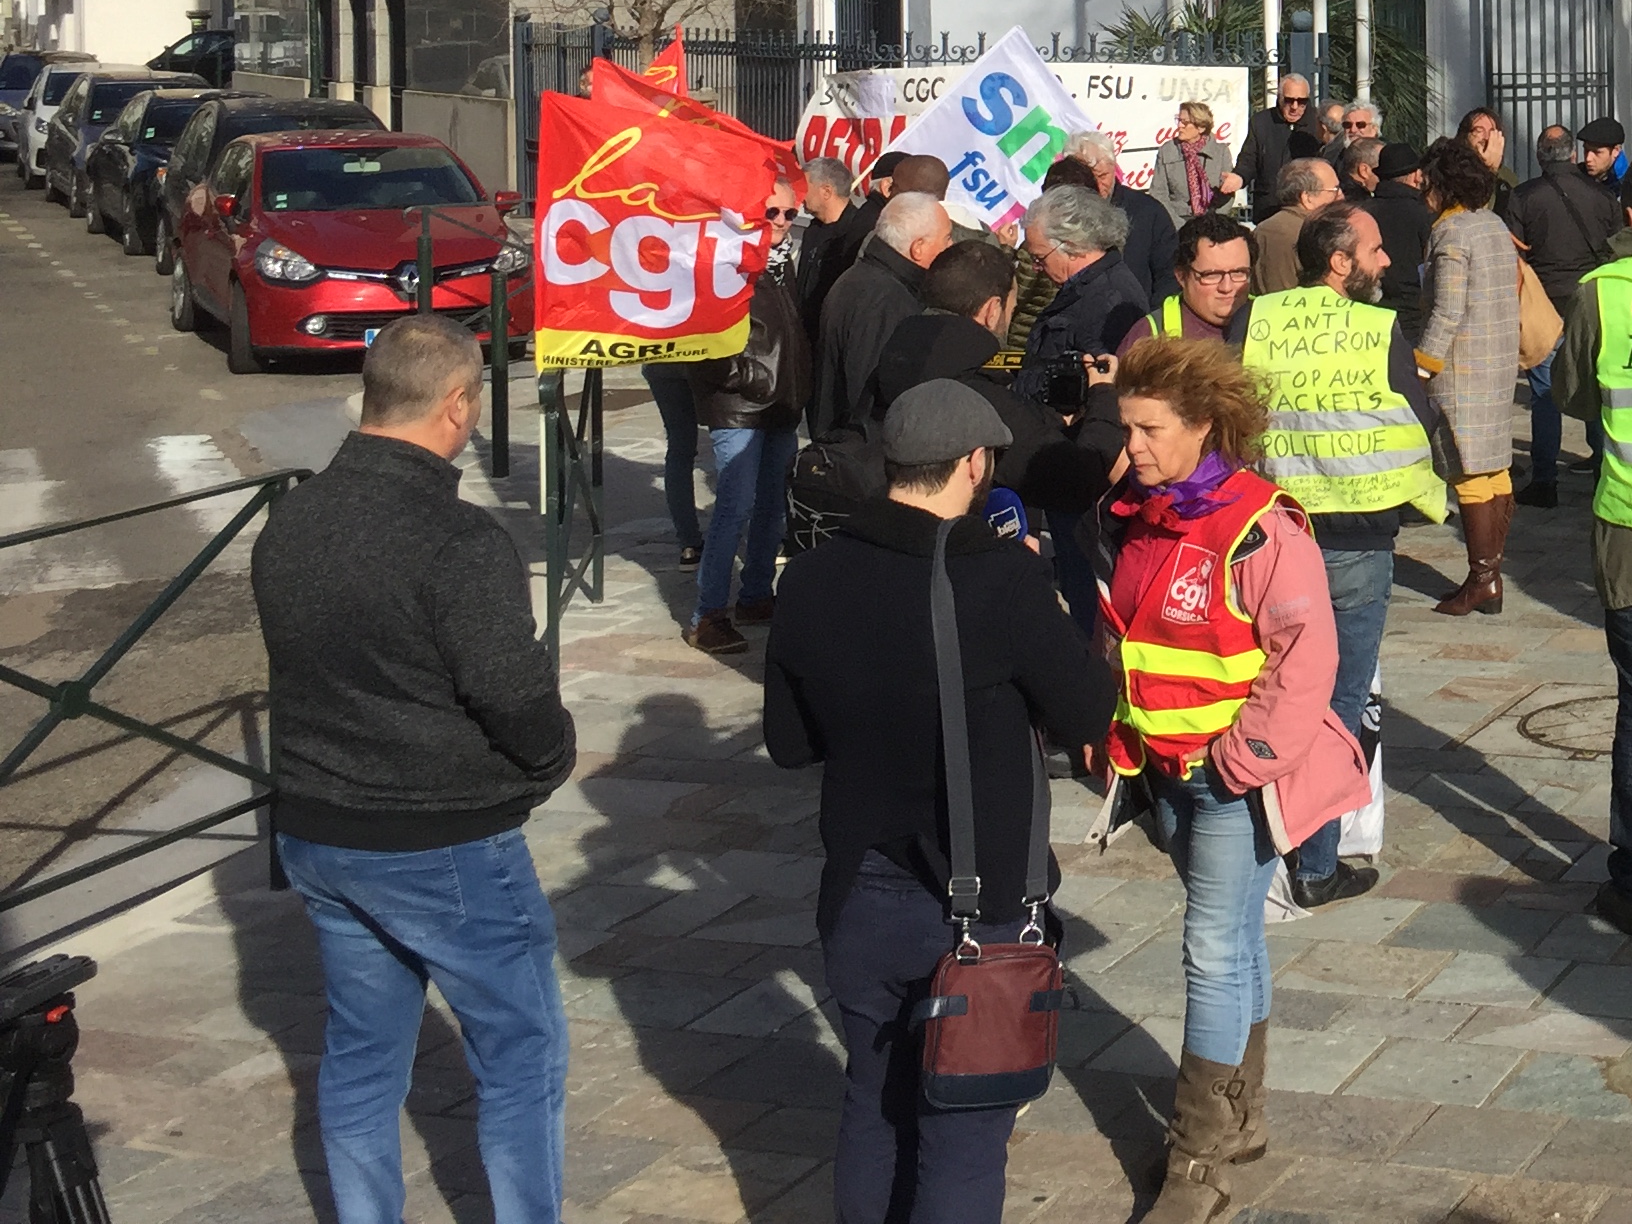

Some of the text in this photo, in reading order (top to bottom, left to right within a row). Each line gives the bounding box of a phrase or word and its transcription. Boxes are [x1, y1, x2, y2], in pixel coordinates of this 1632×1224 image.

[1087, 75, 1134, 100] FSU
[1158, 76, 1232, 103] UNSA
[541, 198, 763, 328] cgt
[1281, 295, 1307, 308] LA
[1281, 310, 1351, 332] ANTI
[579, 339, 676, 358] AGRI
[1269, 331, 1382, 361] MACRON
[1328, 369, 1377, 388] AUX
[1261, 429, 1387, 459] POLITIQUE
[1170, 579, 1208, 612] cgt
[1164, 605, 1205, 623] CORSICA
